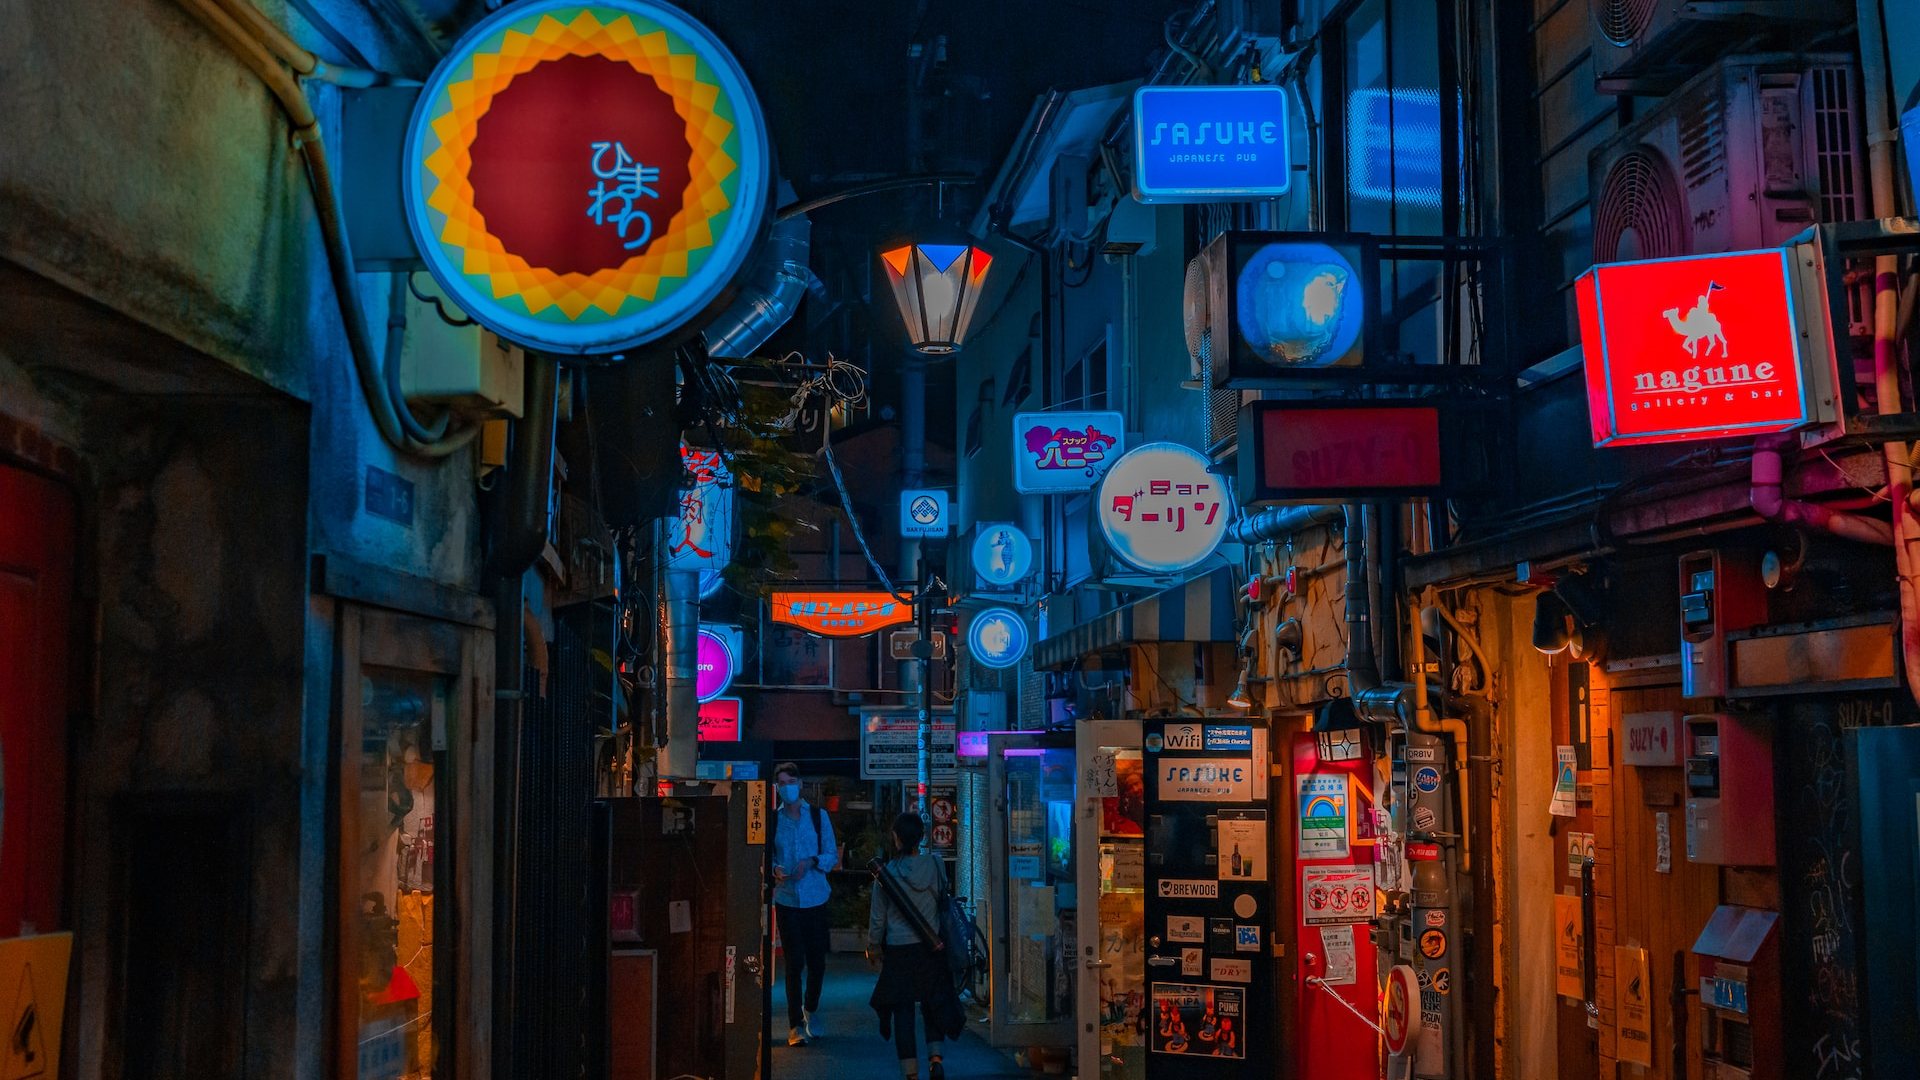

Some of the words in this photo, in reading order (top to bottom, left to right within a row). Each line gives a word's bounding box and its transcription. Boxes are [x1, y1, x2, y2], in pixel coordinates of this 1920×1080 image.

[1151, 121, 1277, 146] SASUKE
[1169, 153, 1225, 163] JAPANESE
[1236, 153, 1258, 163] PUB
[586, 140, 660, 249] ひまわり
[1634, 359, 1775, 393] nagune
[1630, 394, 1709, 411] gallery
[1724, 392, 1735, 402] &
[1751, 387, 1784, 399] bar
[1062, 437, 1088, 446] スナック
[1038, 440, 1104, 469] ハニー
[1150, 480, 1210, 495] Bar
[1112, 495, 1220, 532] ダーリン
[1165, 734, 1202, 749] Wifi
[1166, 767, 1244, 783] SASUKE
[1173, 884, 1216, 896] BREWDOG
[1218, 1002, 1239, 1013] PUNK
